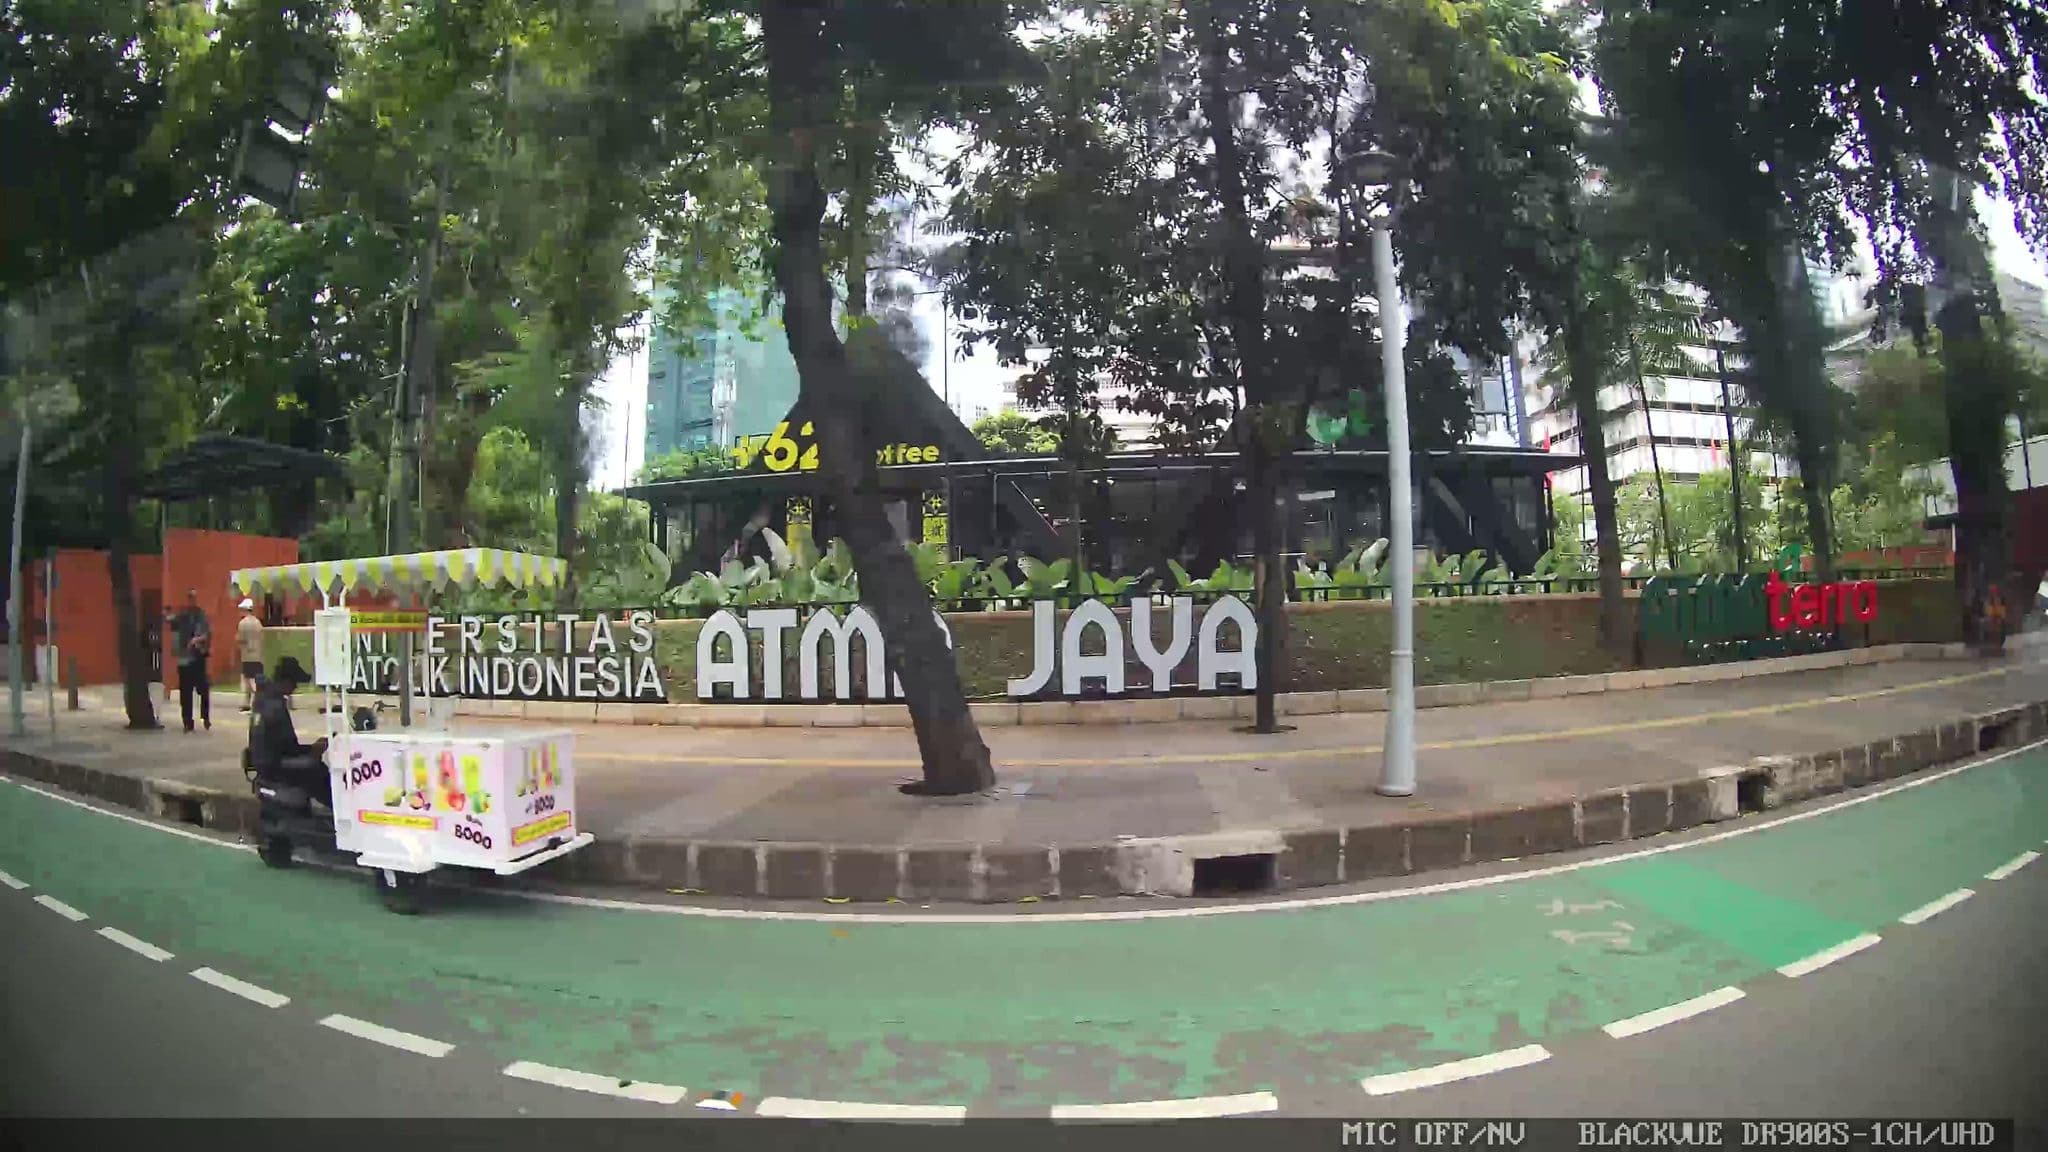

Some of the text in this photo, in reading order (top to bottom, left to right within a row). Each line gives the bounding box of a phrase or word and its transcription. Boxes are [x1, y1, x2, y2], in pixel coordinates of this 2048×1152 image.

[1764, 569, 1878, 630] terra
[1007, 595, 1259, 697] JAYA
[460, 656, 665, 699] INDONESIA
[455, 824, 492, 850] 8000
